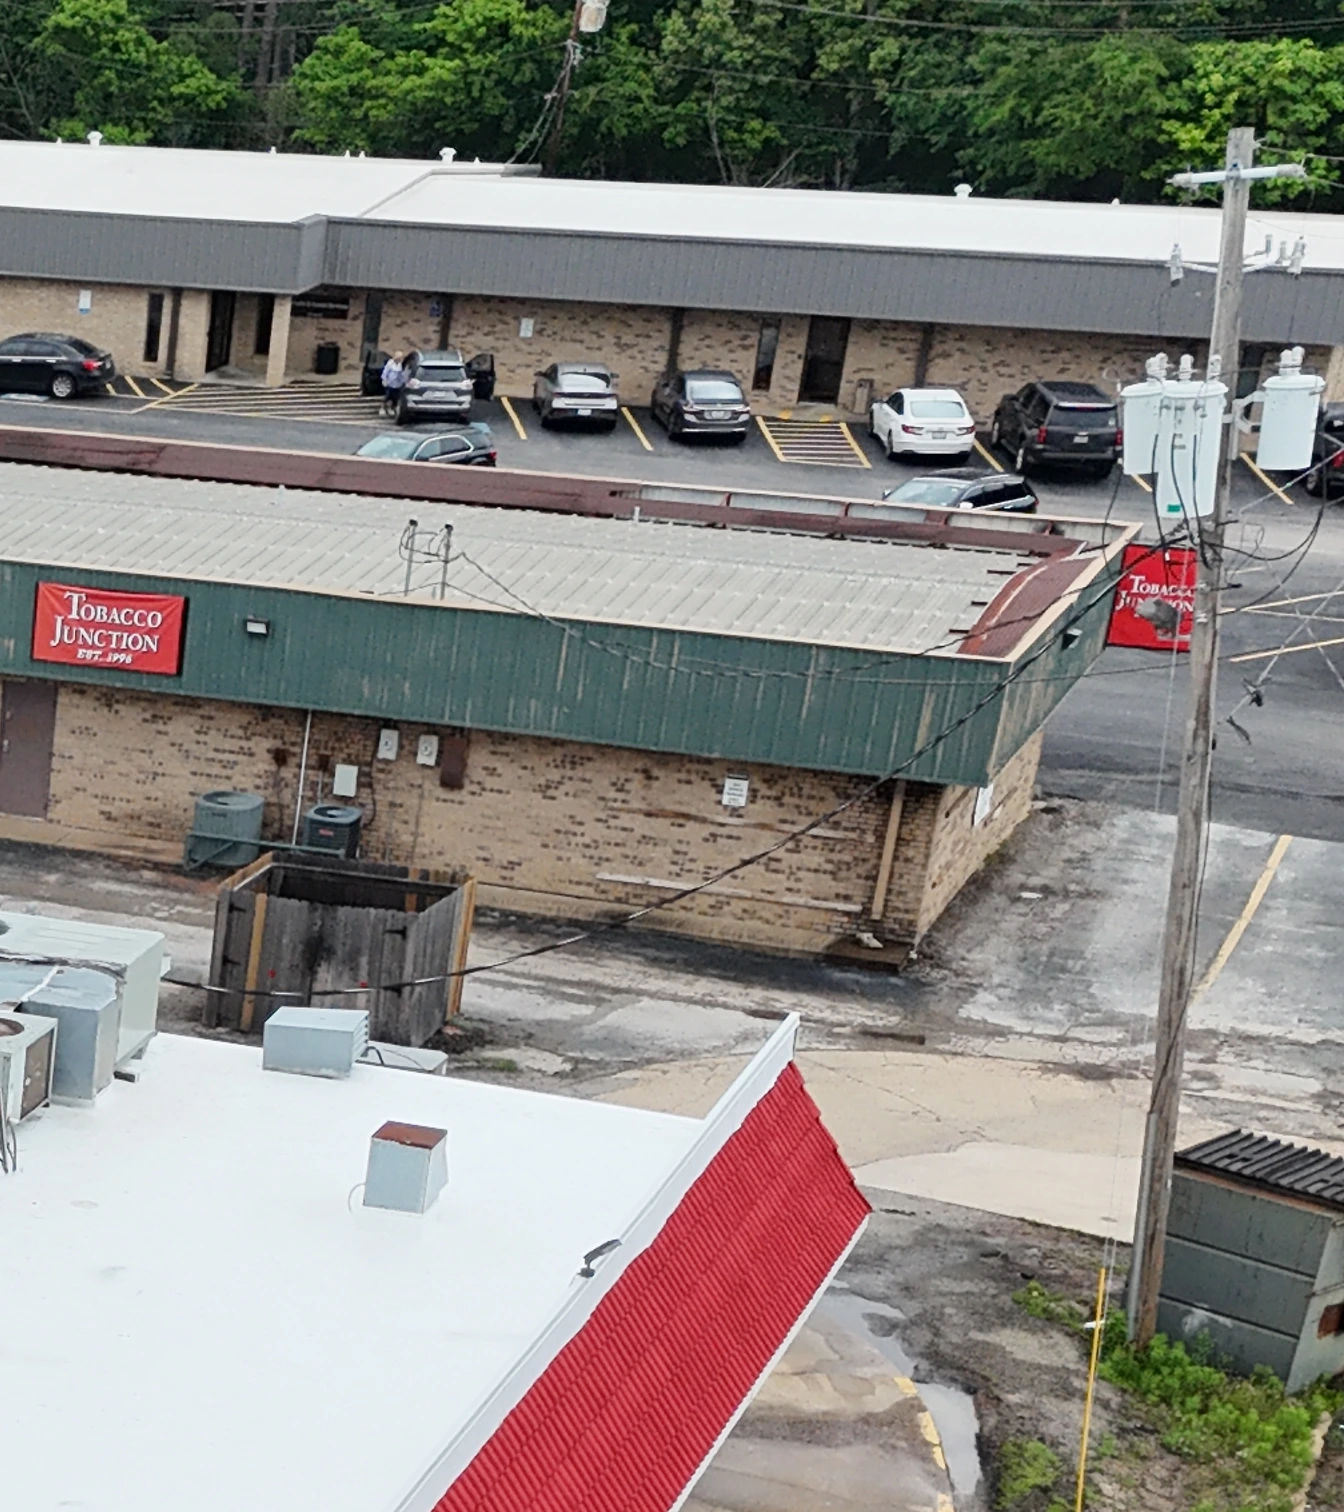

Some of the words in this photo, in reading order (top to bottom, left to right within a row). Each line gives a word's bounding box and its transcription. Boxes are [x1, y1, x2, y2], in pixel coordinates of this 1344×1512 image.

[64, 591, 163, 628] TOBACCO
[50, 615, 160, 652] JUNCTION
[76, 648, 103, 661] EST.
[106, 652, 133, 664] 1996
